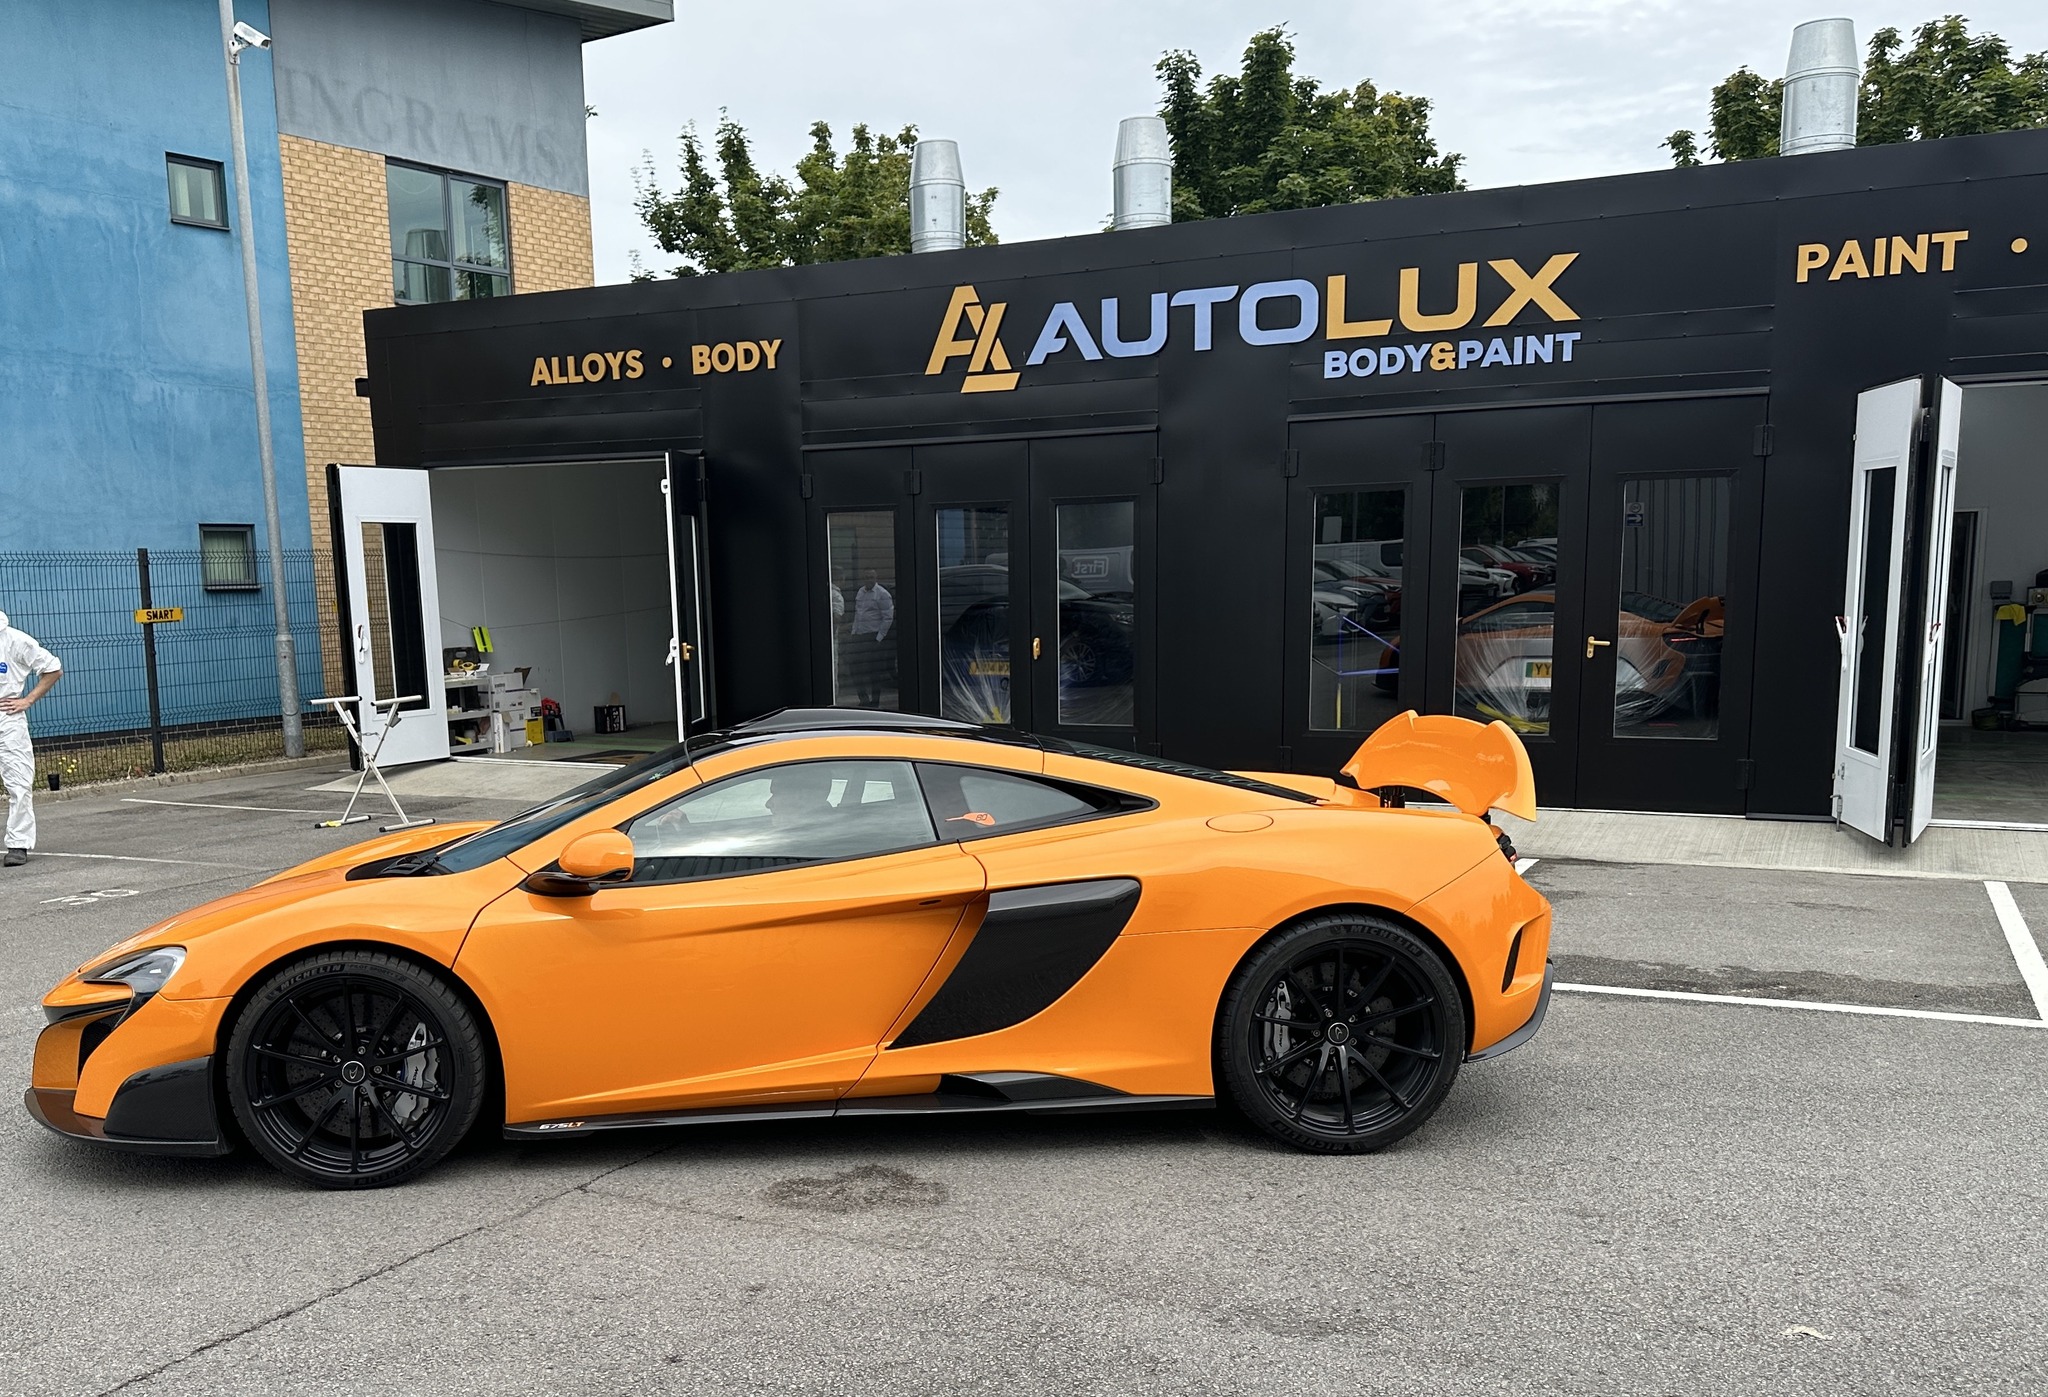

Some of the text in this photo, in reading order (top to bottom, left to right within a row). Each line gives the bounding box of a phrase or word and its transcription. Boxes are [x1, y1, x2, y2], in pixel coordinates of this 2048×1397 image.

[1796, 230, 1969, 283] PAINT
[1026, 252, 1580, 366] AUTOLUX
[530, 339, 782, 386] ALLOYS BODY
[1323, 331, 1582, 379] BODY&PAINT
[146, 609, 174, 620] SMART
[1350, 925, 1420, 954] MICHELIN
[280, 964, 342, 990] MICHELIN
[539, 1121, 585, 1130] 675LT
